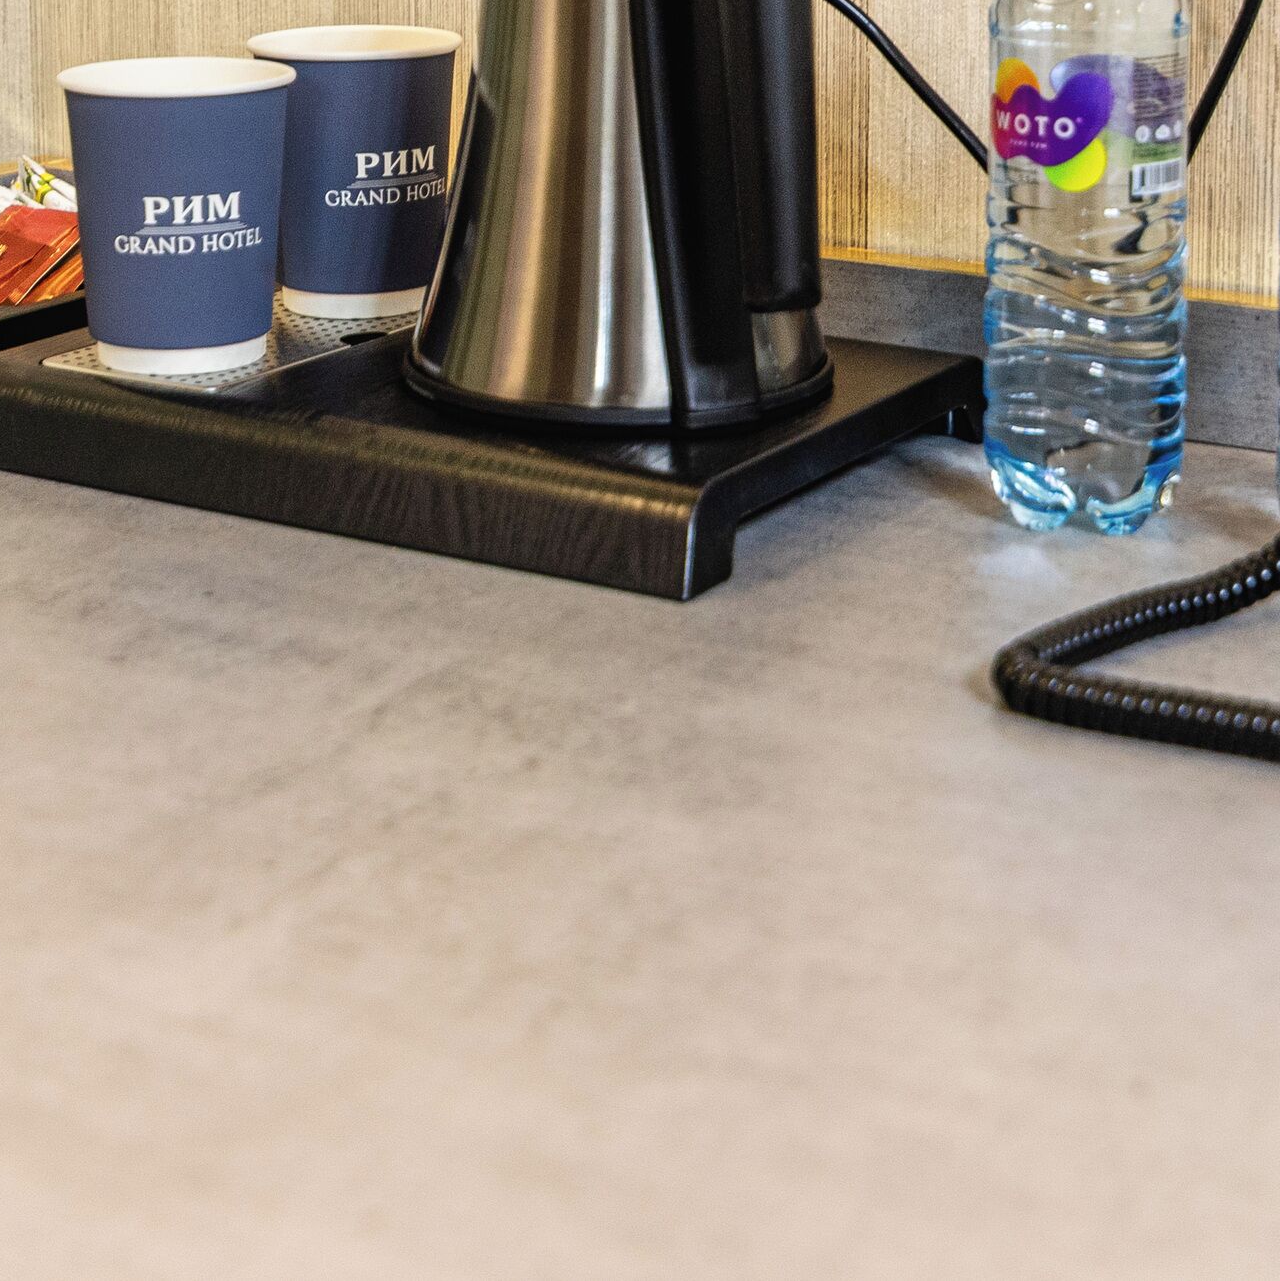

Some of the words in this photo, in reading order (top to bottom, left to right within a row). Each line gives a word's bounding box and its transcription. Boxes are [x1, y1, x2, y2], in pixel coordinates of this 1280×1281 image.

[996, 109, 1076, 140] WOTO
[354, 145, 436, 179] РИМ
[142, 191, 241, 225] РИМ
[324, 187, 401, 207] GRAND
[114, 234, 196, 255] GRAND
[201, 226, 263, 253] HOTEL
